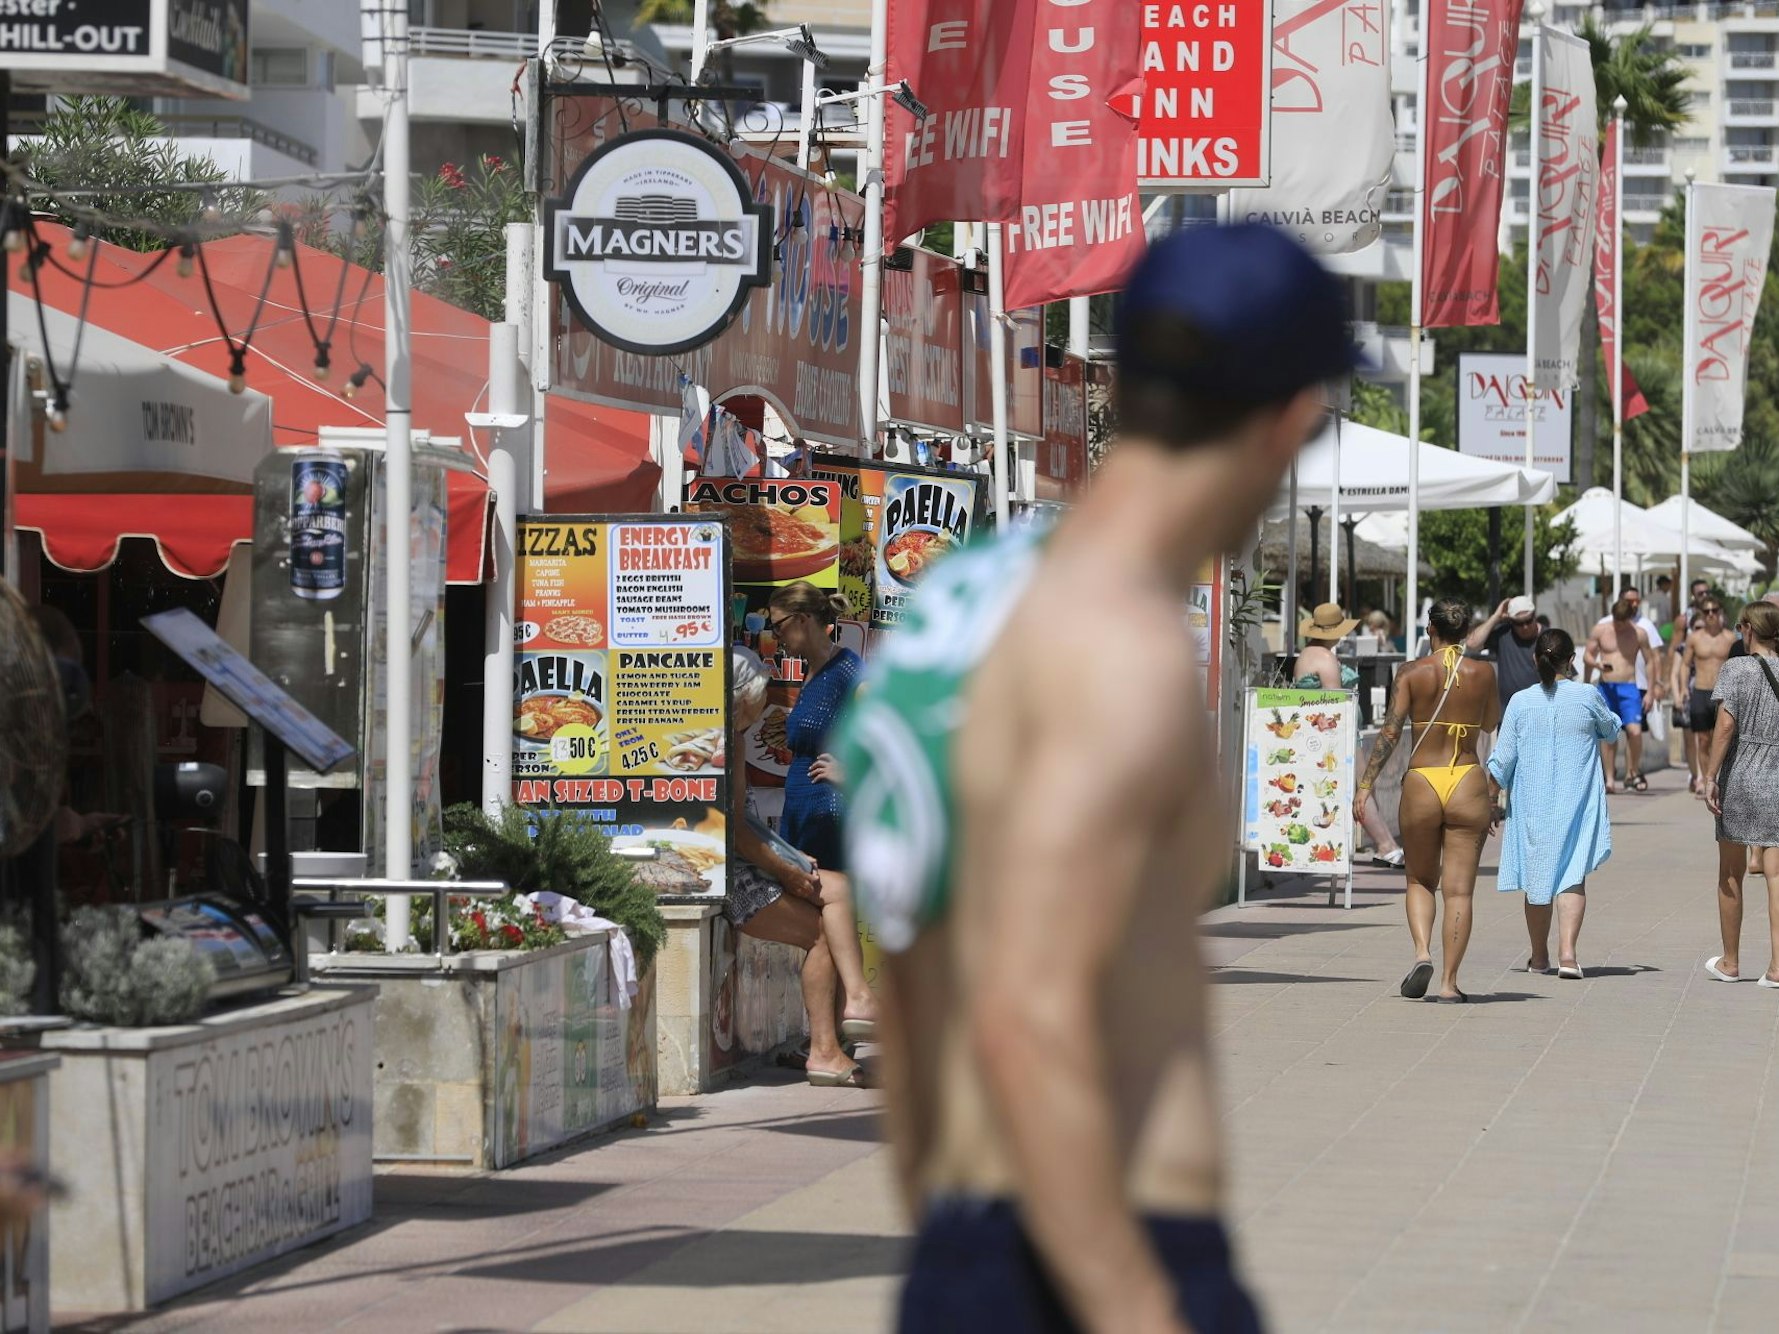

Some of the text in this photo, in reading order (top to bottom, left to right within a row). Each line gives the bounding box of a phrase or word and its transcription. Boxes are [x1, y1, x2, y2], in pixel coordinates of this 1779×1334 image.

[0, 0, 60, 16] ster
[1144, 4, 1236, 28] EACH
[0, 23, 143, 51] HILL-OUT
[1143, 41, 1235, 72] AND
[1048, 0, 1095, 147] USE
[1132, 88, 1214, 118] INN
[1482, 20, 1514, 180] PALACE
[944, 107, 1012, 161] WIFI
[1137, 137, 1239, 176] INKS
[640, 178, 675, 186] IRELAND
[655, 169, 693, 185] TIPPERARY
[1564, 134, 1593, 267] PALACE
[1008, 193, 1132, 254] FREE WIFI
[1246, 207, 1380, 227] CALVIÀ BEACH
[567, 224, 744, 260] MAGNERS
[616, 276, 690, 304] Original
[1695, 225, 1749, 386] DAIQUIRI
[1542, 359, 1570, 369] BEACH
[1485, 405, 1547, 421] PALAE
[1347, 487, 1387, 496] ESTRELLA
[886, 484, 968, 546] PAELLA
[516, 528, 597, 556] IZZAS
[619, 526, 691, 546] ENERGY
[618, 547, 712, 572] BREAKFAST
[616, 585, 645, 593] BACON
[622, 575, 644, 583] EGGS
[616, 605, 710, 614] TOMATO MUSHROOMS
[655, 595, 682, 603] BEANS
[884, 594, 907, 607] PER
[619, 652, 714, 669] PANCAKE
[616, 690, 671, 698] CHOCOLATE
[1300, 692, 1340, 707] Smoothies
[614, 727, 638, 740] ONLY
[618, 734, 645, 748] FROM
[512, 752, 537, 761] PER
[587, 736, 596, 759] €
[621, 742, 659, 770] 4.25 €
[553, 779, 625, 803] SIZED
[627, 778, 717, 803] T-BONE
[174, 1017, 354, 1178] TOM BROWN'S
[185, 1178, 244, 1278] BEACH
[244, 1167, 279, 1257] BAR
